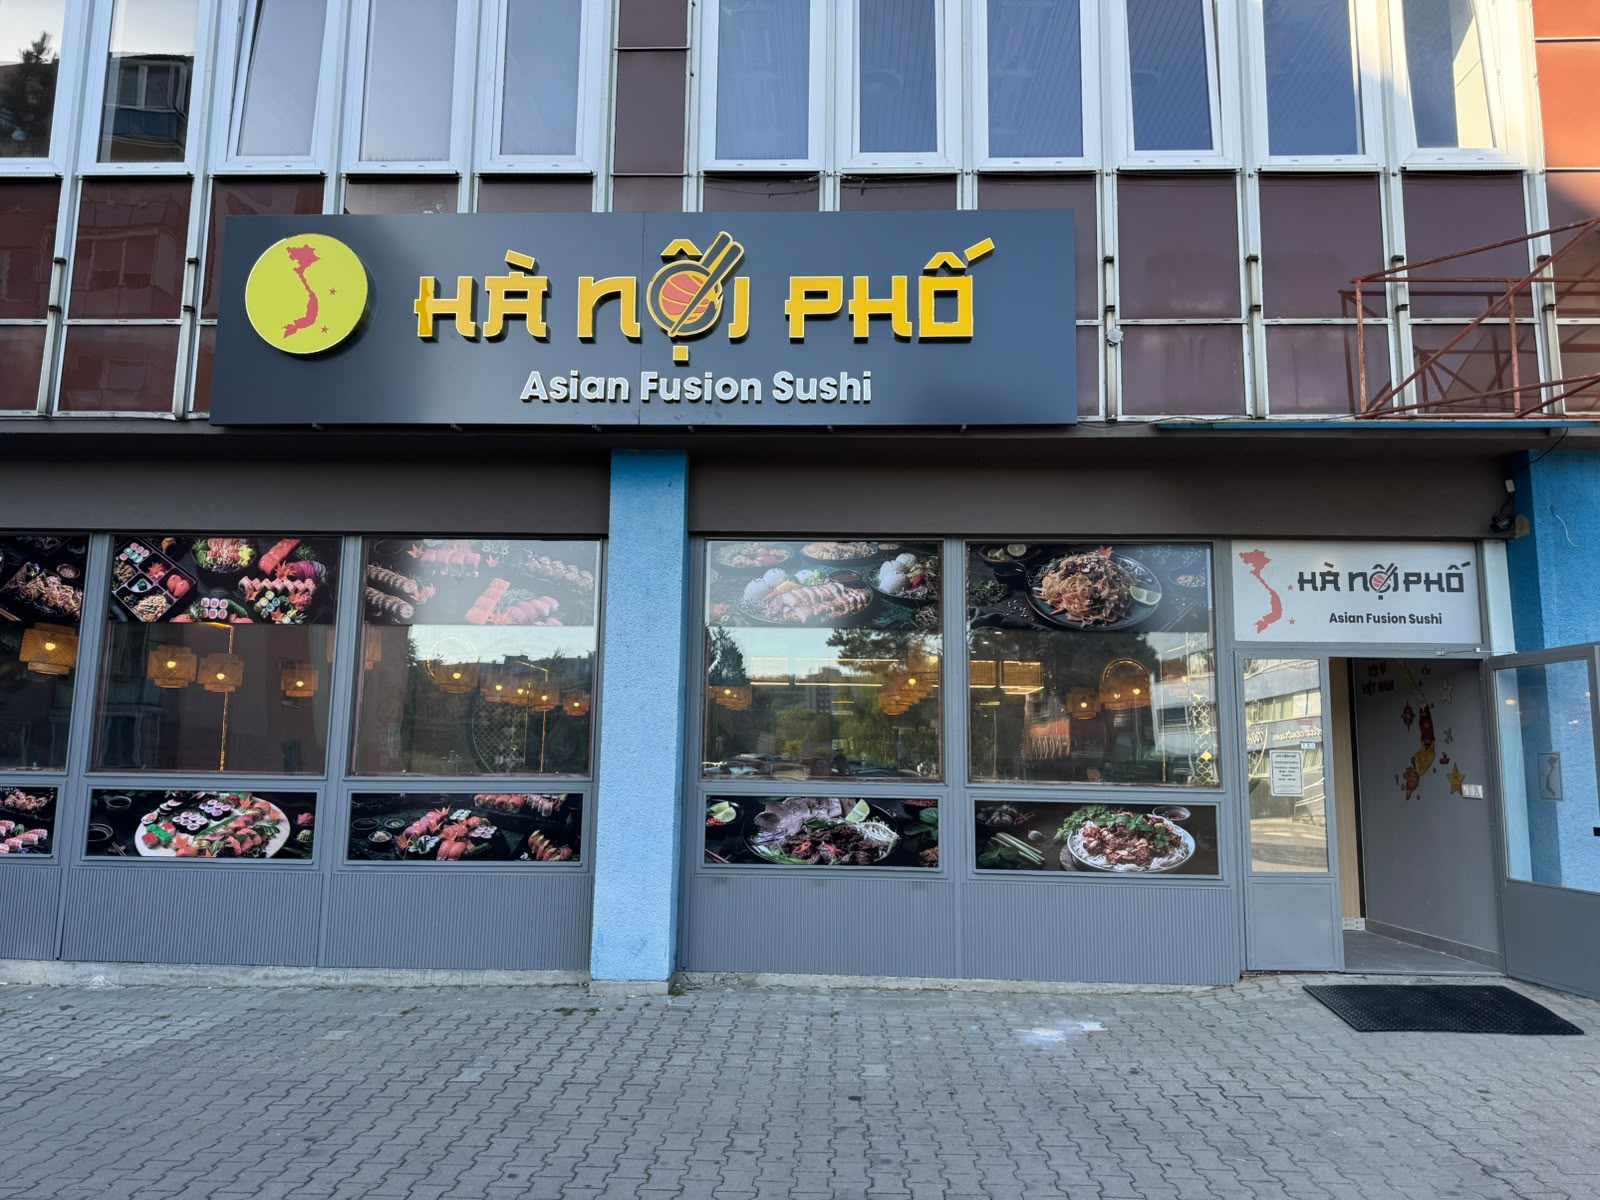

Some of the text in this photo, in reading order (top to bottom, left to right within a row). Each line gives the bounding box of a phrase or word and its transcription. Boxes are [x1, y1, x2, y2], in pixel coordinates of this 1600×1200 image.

[414, 250, 548, 338] HÀ
[785, 238, 995, 338] PHỐ
[520, 370, 871, 402] Asian Fusion Sushi
[1298, 562, 1340, 592] HÀ
[1403, 561, 1471, 593] PHỐ
[1329, 612, 1442, 625] Asian Fusion Sushi
